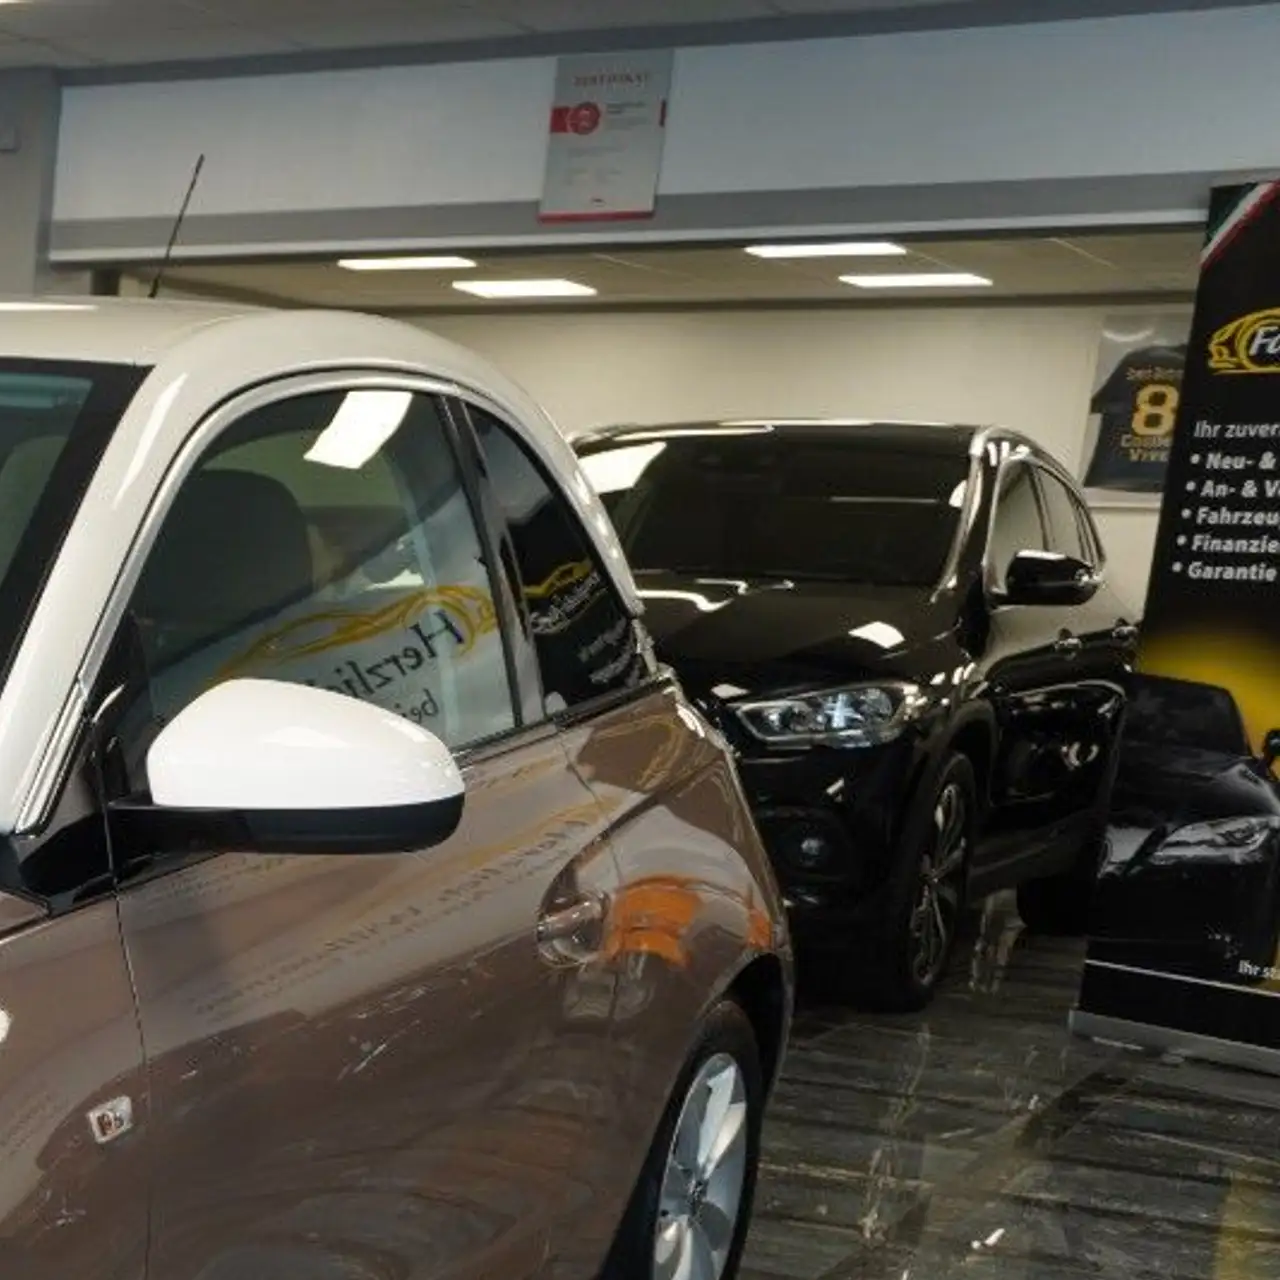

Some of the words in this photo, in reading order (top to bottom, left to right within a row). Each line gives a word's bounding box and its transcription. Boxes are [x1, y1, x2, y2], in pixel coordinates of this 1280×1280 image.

[1131, 384, 1179, 435] 8
[1193, 420, 1222, 438] Ihr
[1205, 452, 1256, 470] Neu-
[1258, 451, 1277, 470] &
[1200, 479, 1236, 498] An-
[1241, 479, 1258, 498] &
[1264, 479, 1280, 498] V
[1195, 506, 1280, 526] Fahrzeu
[1187, 561, 1278, 581] Garantie
